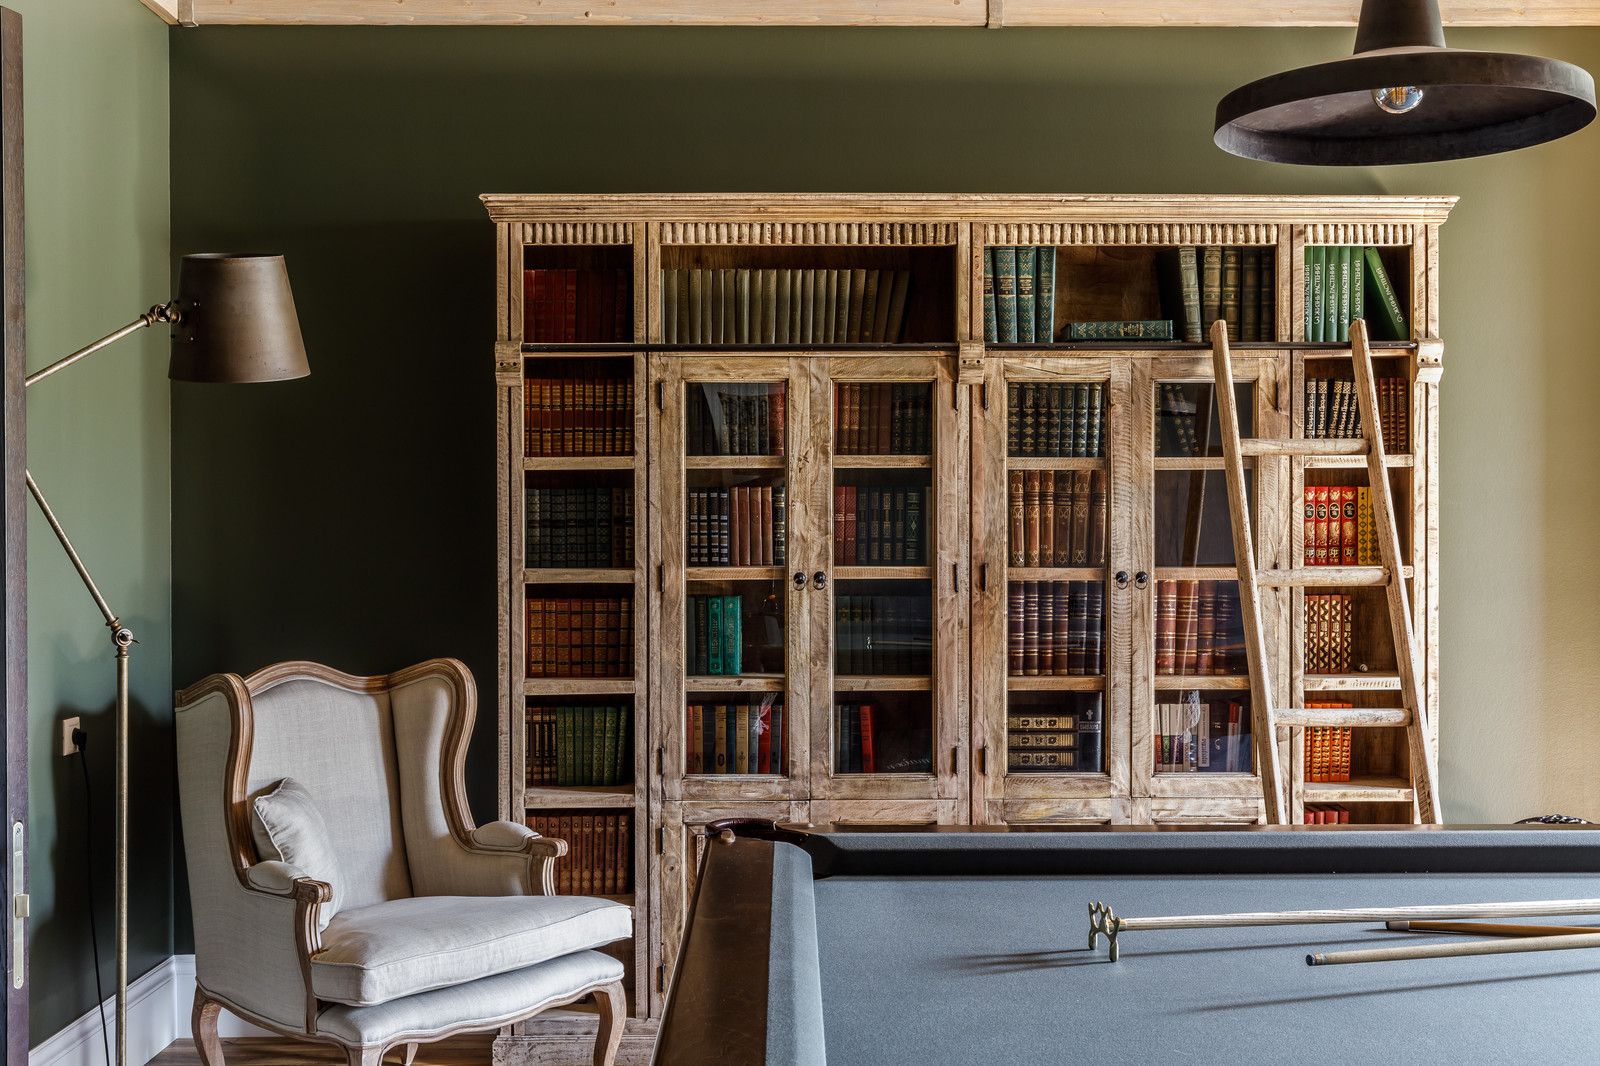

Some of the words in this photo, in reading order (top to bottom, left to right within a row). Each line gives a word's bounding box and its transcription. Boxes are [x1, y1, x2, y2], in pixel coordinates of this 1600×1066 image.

[1313, 263, 1321, 294] РАСТЕНИЙ
[1340, 263, 1348, 294] РАСТЕНИЙ
[1353, 260, 1361, 291] РАСТЕНИЙ
[1375, 266, 1392, 295] РАСТЕНИЙ
[1388, 294, 1400, 314] ЖИЗНЬ
